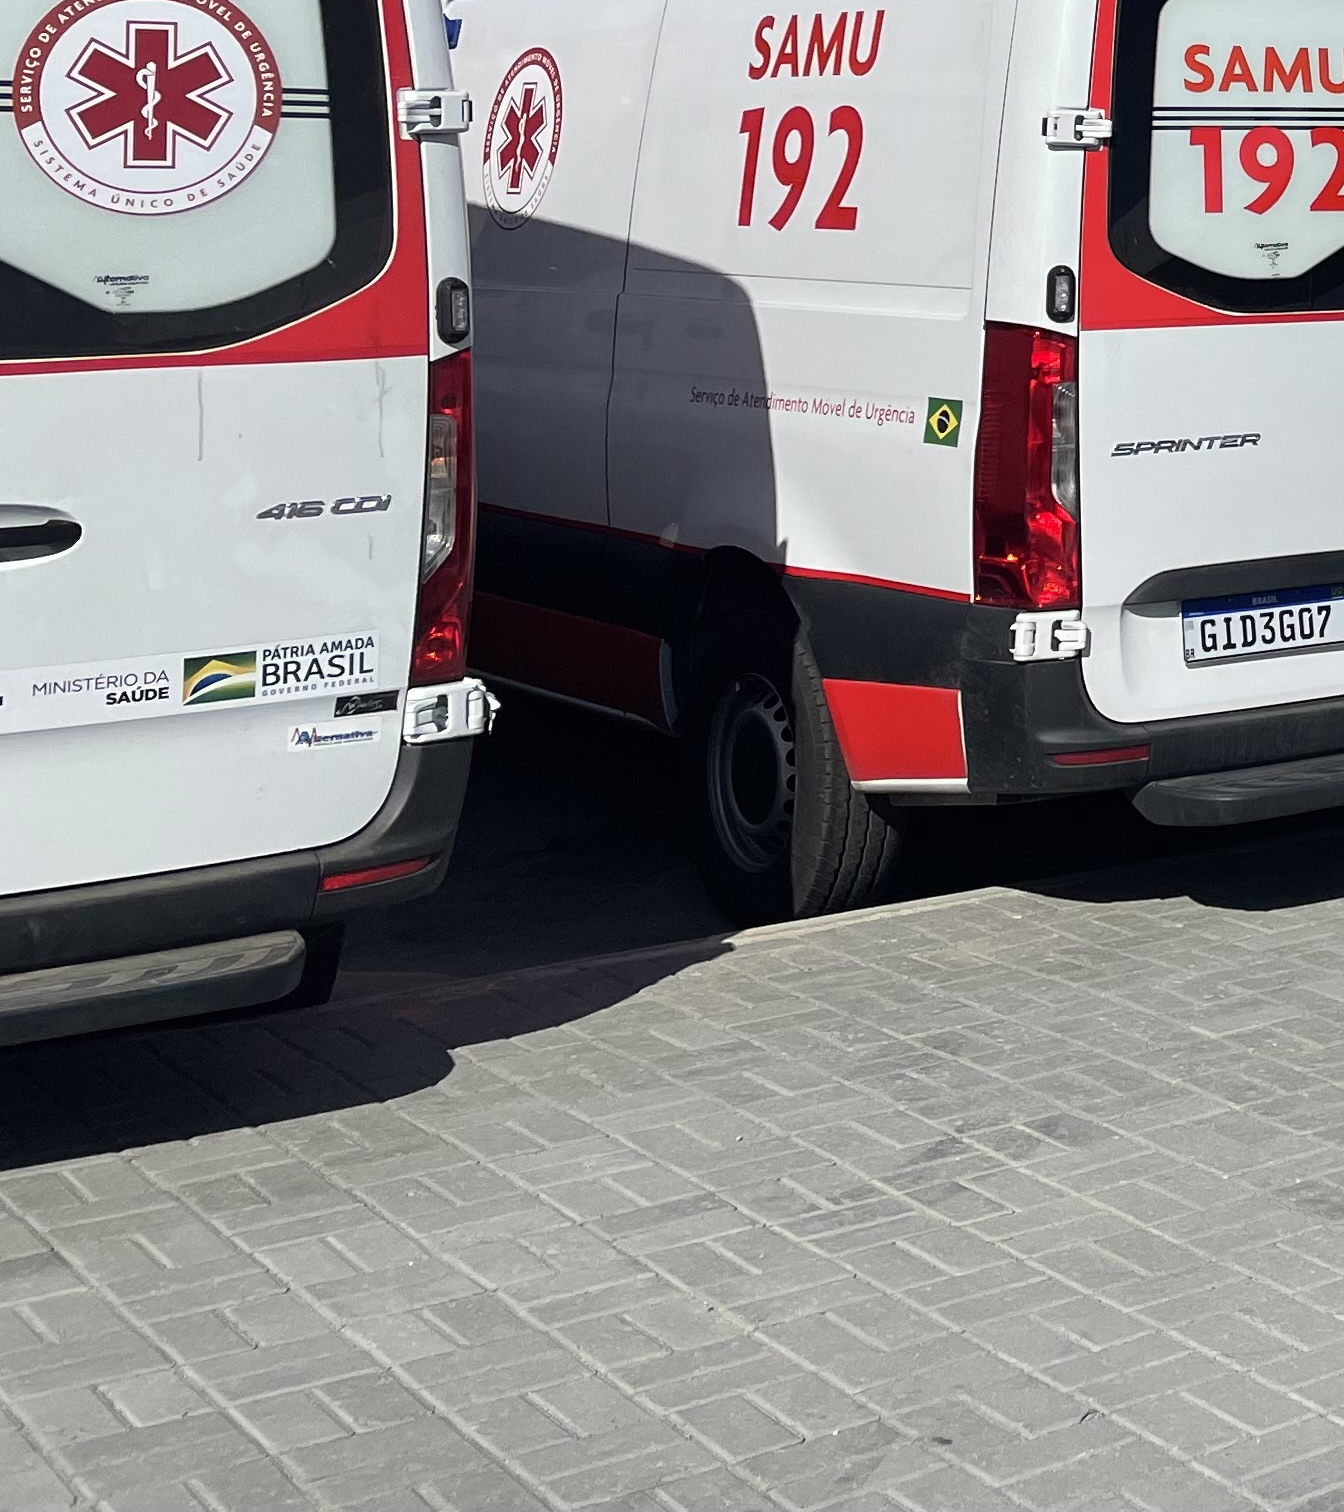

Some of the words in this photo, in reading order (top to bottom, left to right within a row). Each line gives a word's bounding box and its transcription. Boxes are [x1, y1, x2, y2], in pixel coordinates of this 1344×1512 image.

[748, 9, 885, 80] SAMU
[20, 46, 42, 113] SERVIÇO
[38, 23, 57, 44] DE
[234, 22, 253, 40] DE
[250, 42, 275, 118] URGÊNCIA
[33, 140, 97, 198] SISTEMA
[110, 192, 174, 209] ÚNICO
[187, 189, 208, 202] DE
[217, 144, 262, 188] SAÚDE
[737, 104, 864, 232] 192
[689, 385, 725, 408] Serviço
[727, 388, 740, 406] de
[742, 390, 809, 414] Atendimento
[811, 397, 845, 418] Móvel
[848, 399, 862, 418] de
[865, 402, 915, 426] Urgência
[1110, 432, 1262, 457] SPRINTER
[256, 500, 325, 520] 416
[330, 494, 392, 515] CDI
[1252, 595, 1278, 606] BRASIL
[1200, 605, 1331, 653] GID3G07
[262, 644, 316, 662] PÁTRIA
[319, 635, 375, 654] AMADA
[32, 671, 138, 697] MINISTÉRIO
[143, 669, 170, 684] DA
[262, 651, 375, 687] BRASIL
[106, 685, 170, 706] SAÚDE
[262, 683, 317, 697] GOVERNO
[324, 675, 375, 690] FEDERAL
